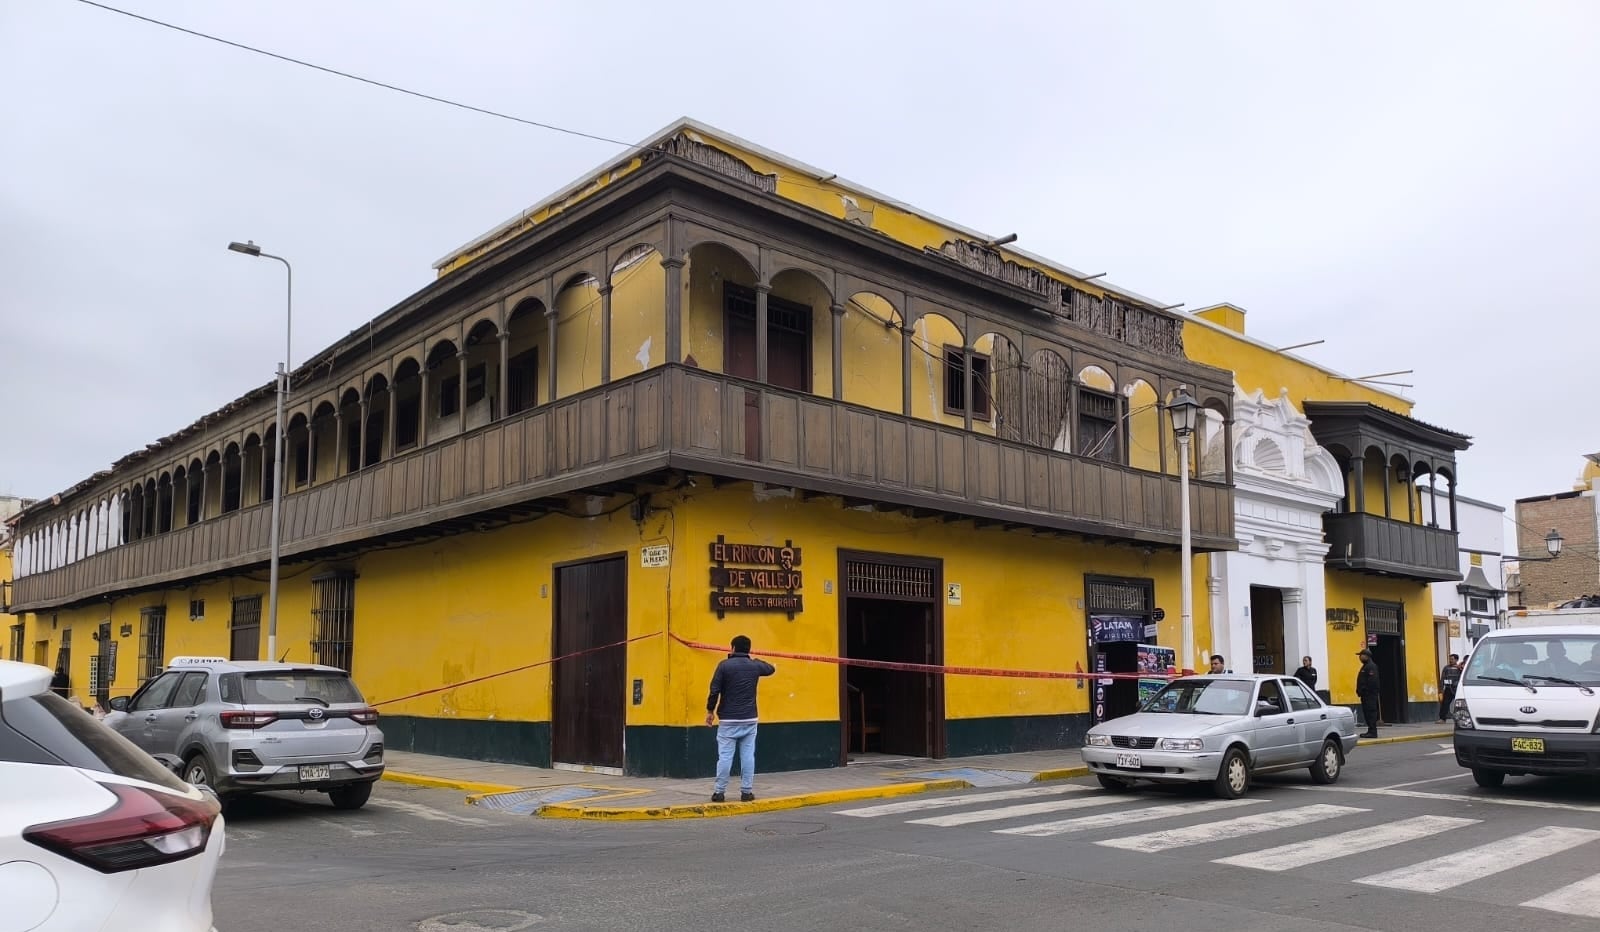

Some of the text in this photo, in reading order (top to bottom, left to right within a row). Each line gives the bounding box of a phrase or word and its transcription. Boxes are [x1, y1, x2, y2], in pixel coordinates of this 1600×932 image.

[714, 544, 775, 564] EL RINCON
[728, 570, 800, 590] DE VALLEJO
[718, 597, 798, 608] CAFE RESTAURANT
[1103, 621, 1133, 630] LATAM
